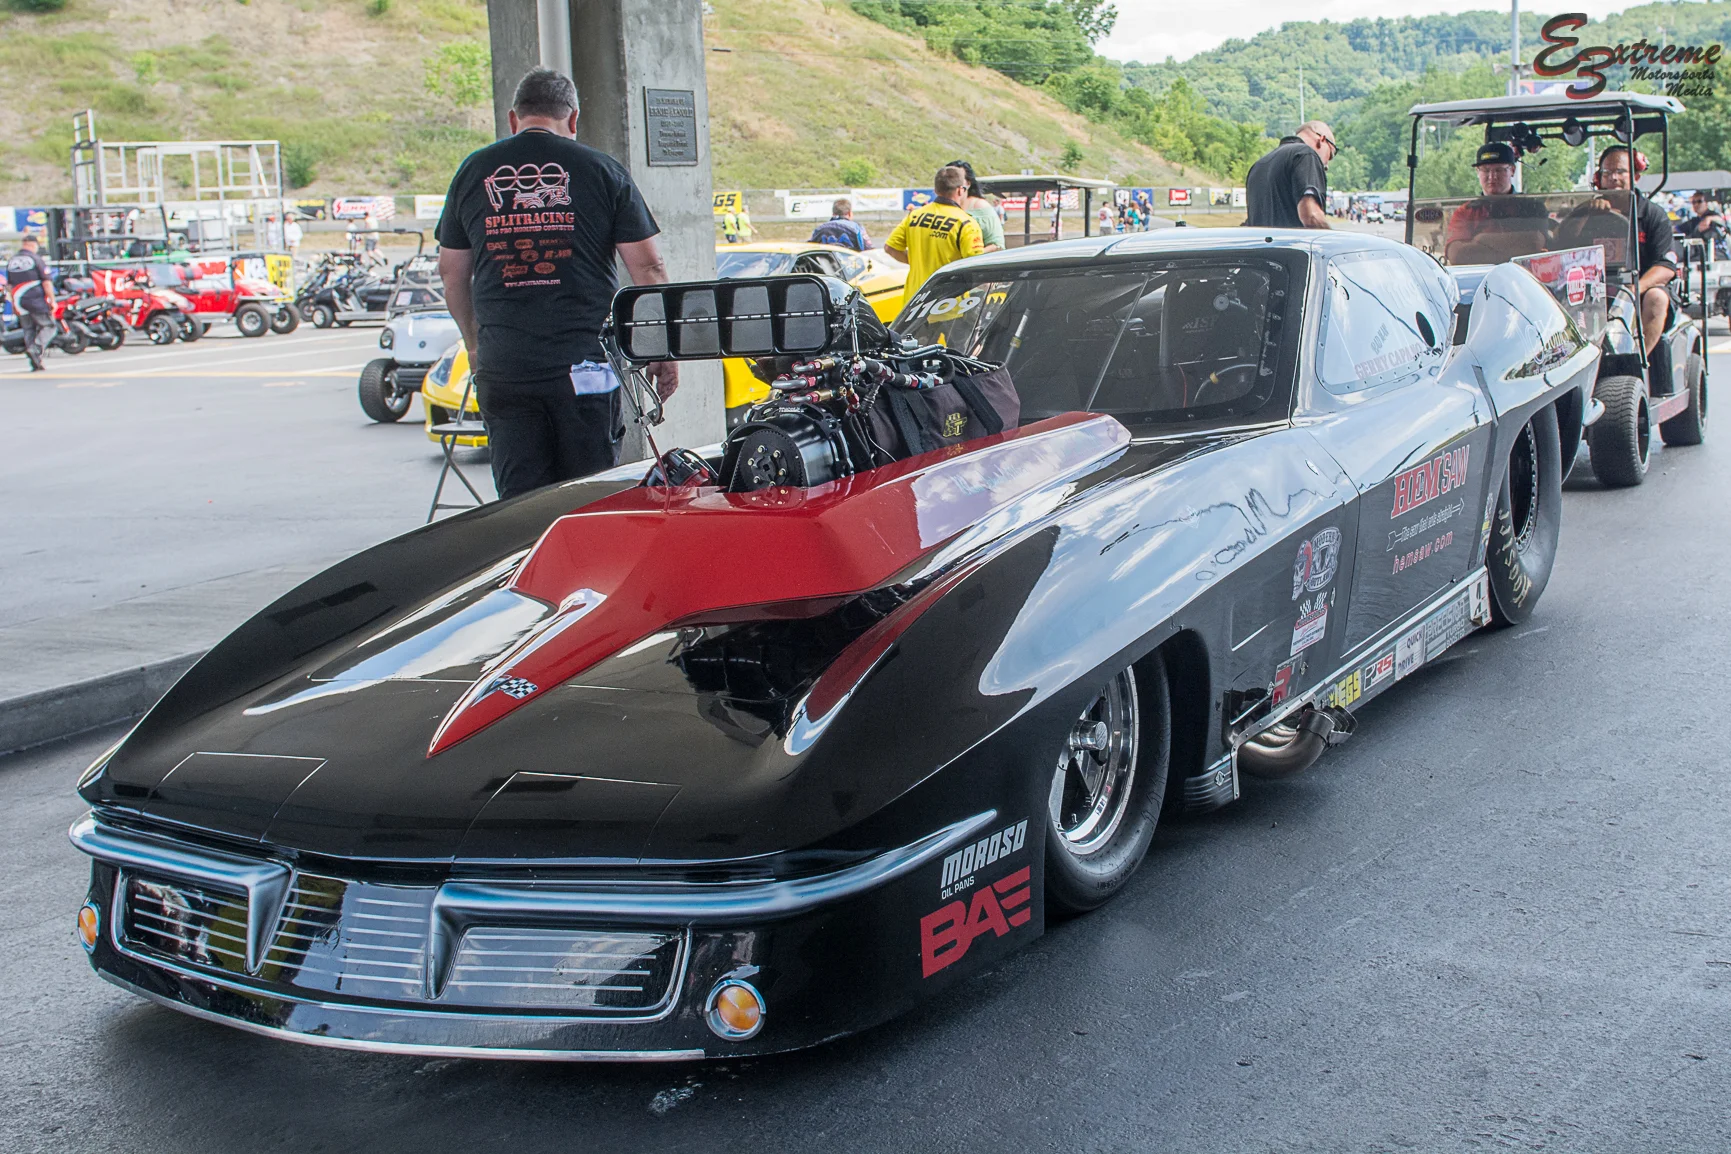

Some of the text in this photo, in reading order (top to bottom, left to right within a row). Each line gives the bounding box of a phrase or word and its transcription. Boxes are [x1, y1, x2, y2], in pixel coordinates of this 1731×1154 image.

[485, 212, 575, 229] SPLITRACING
[910, 213, 958, 232] JEGS
[905, 296, 981, 323] 1109
[1392, 531, 1454, 574] hemsaw.com
[1446, 619, 1465, 638] TURBO
[1407, 630, 1423, 649] QUICK
[1397, 653, 1414, 672] DRIVE
[941, 820, 1028, 888] MOROSO
[941, 876, 975, 900] OIL PANS
[920, 865, 1031, 979] BAE
